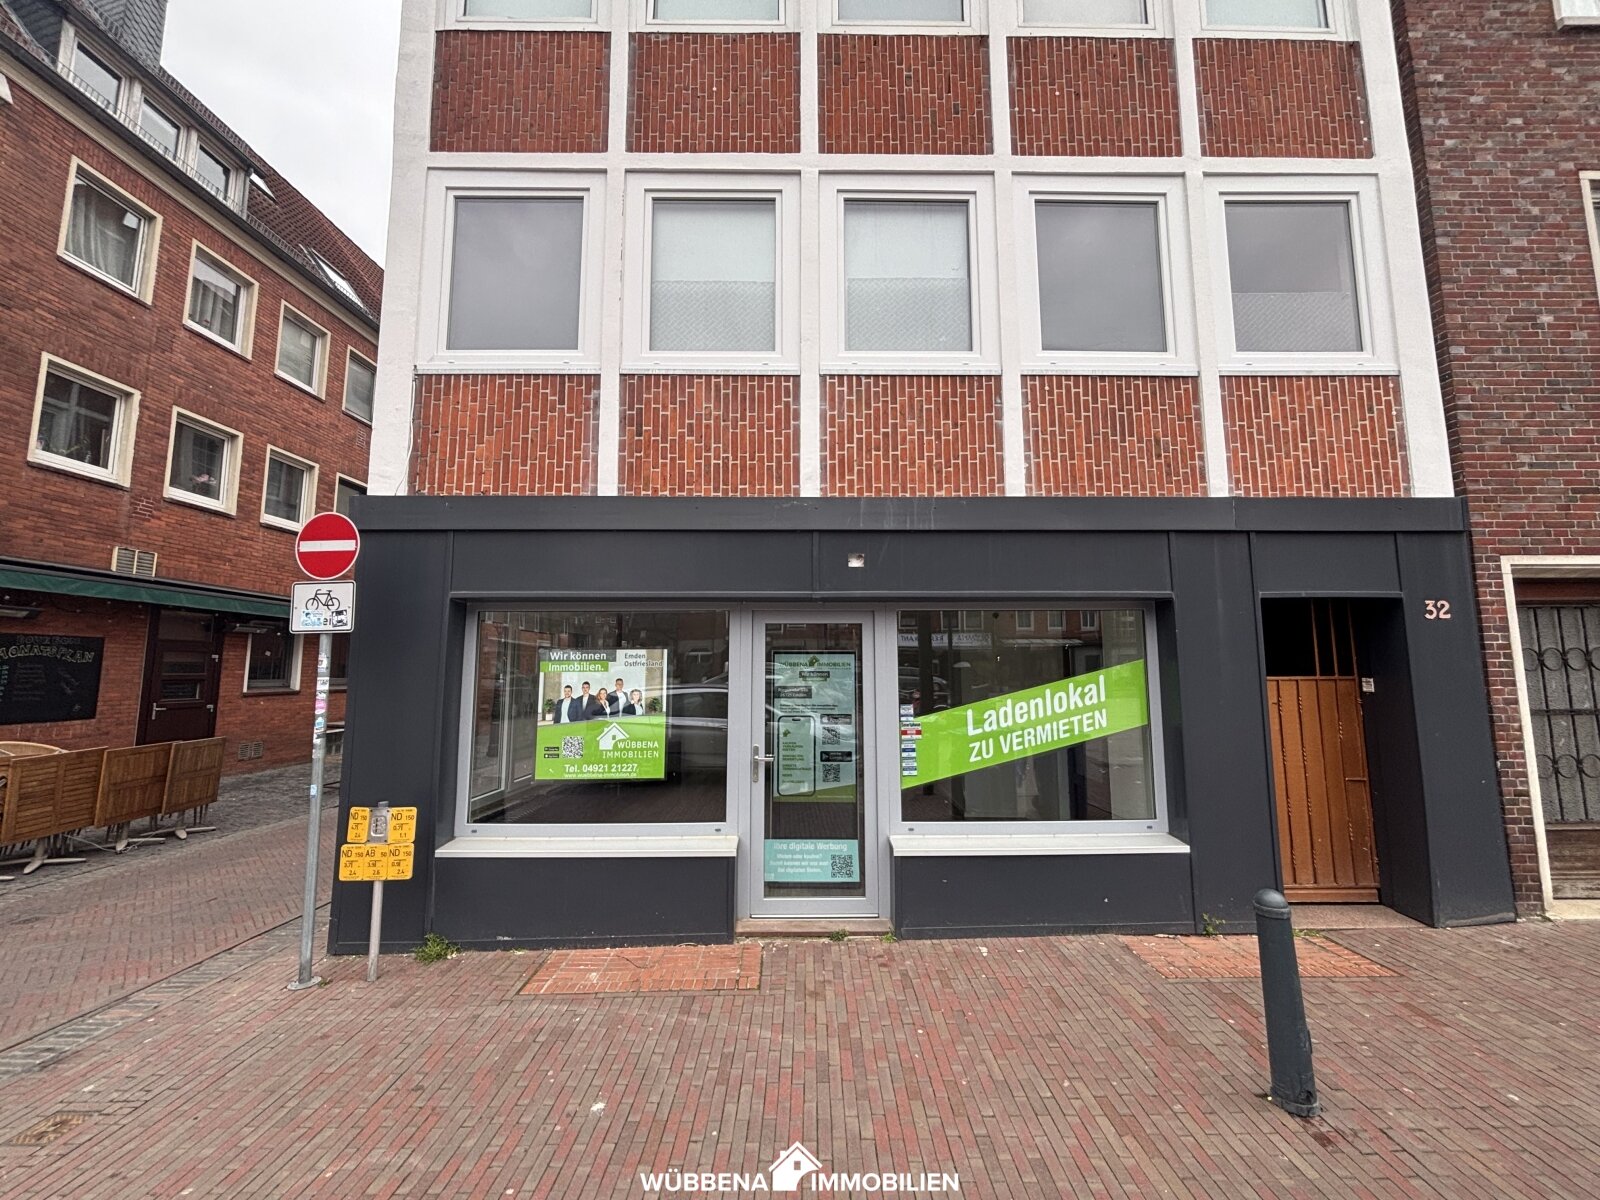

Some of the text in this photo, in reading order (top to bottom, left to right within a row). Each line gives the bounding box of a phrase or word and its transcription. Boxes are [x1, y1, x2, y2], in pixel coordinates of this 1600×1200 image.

[1424, 600, 1451, 619] 32
[550, 652, 606, 660] Wir können
[548, 662, 604, 671] Immobilien.
[966, 675, 1106, 736] Ladenlokal
[969, 708, 1108, 763] ZU VERMIETEN
[617, 740, 659, 748] WÜBBENA
[564, 763, 638, 772] Tel. 04921 21227
[351, 812, 359, 820] ND
[789, 842, 814, 851] digitale
[816, 842, 848, 851] Werbung
